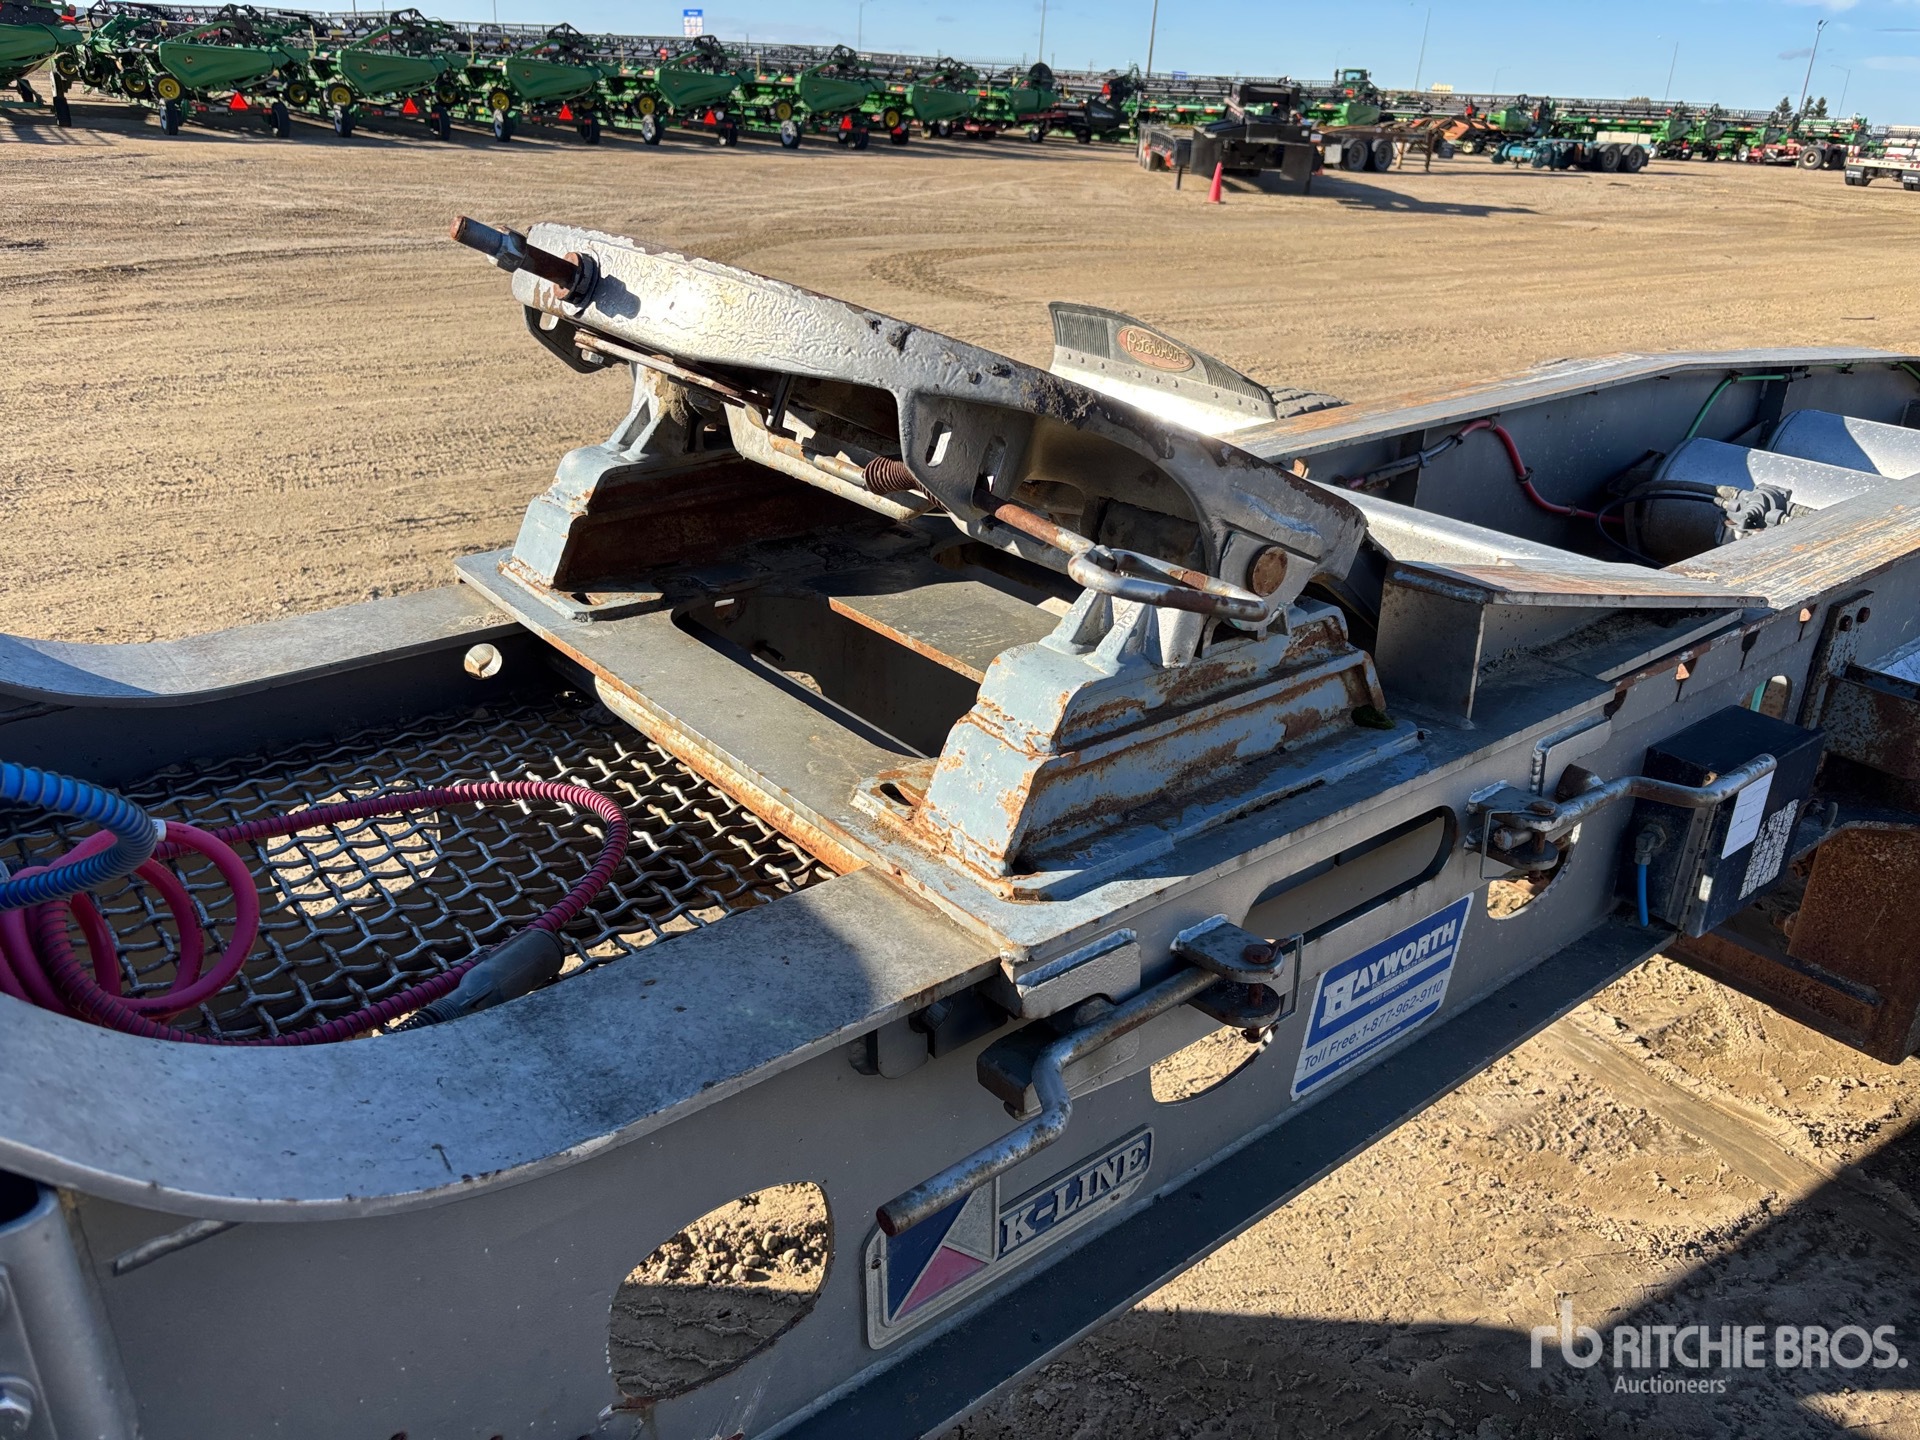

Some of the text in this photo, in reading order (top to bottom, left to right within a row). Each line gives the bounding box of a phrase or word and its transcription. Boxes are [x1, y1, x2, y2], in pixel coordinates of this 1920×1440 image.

[1304, 979, 1444, 1071] Toll Free: 1-877-962-9110
[1319, 919, 1457, 1028] HAYWORTH
[1002, 1140, 1147, 1252] K-LINE
